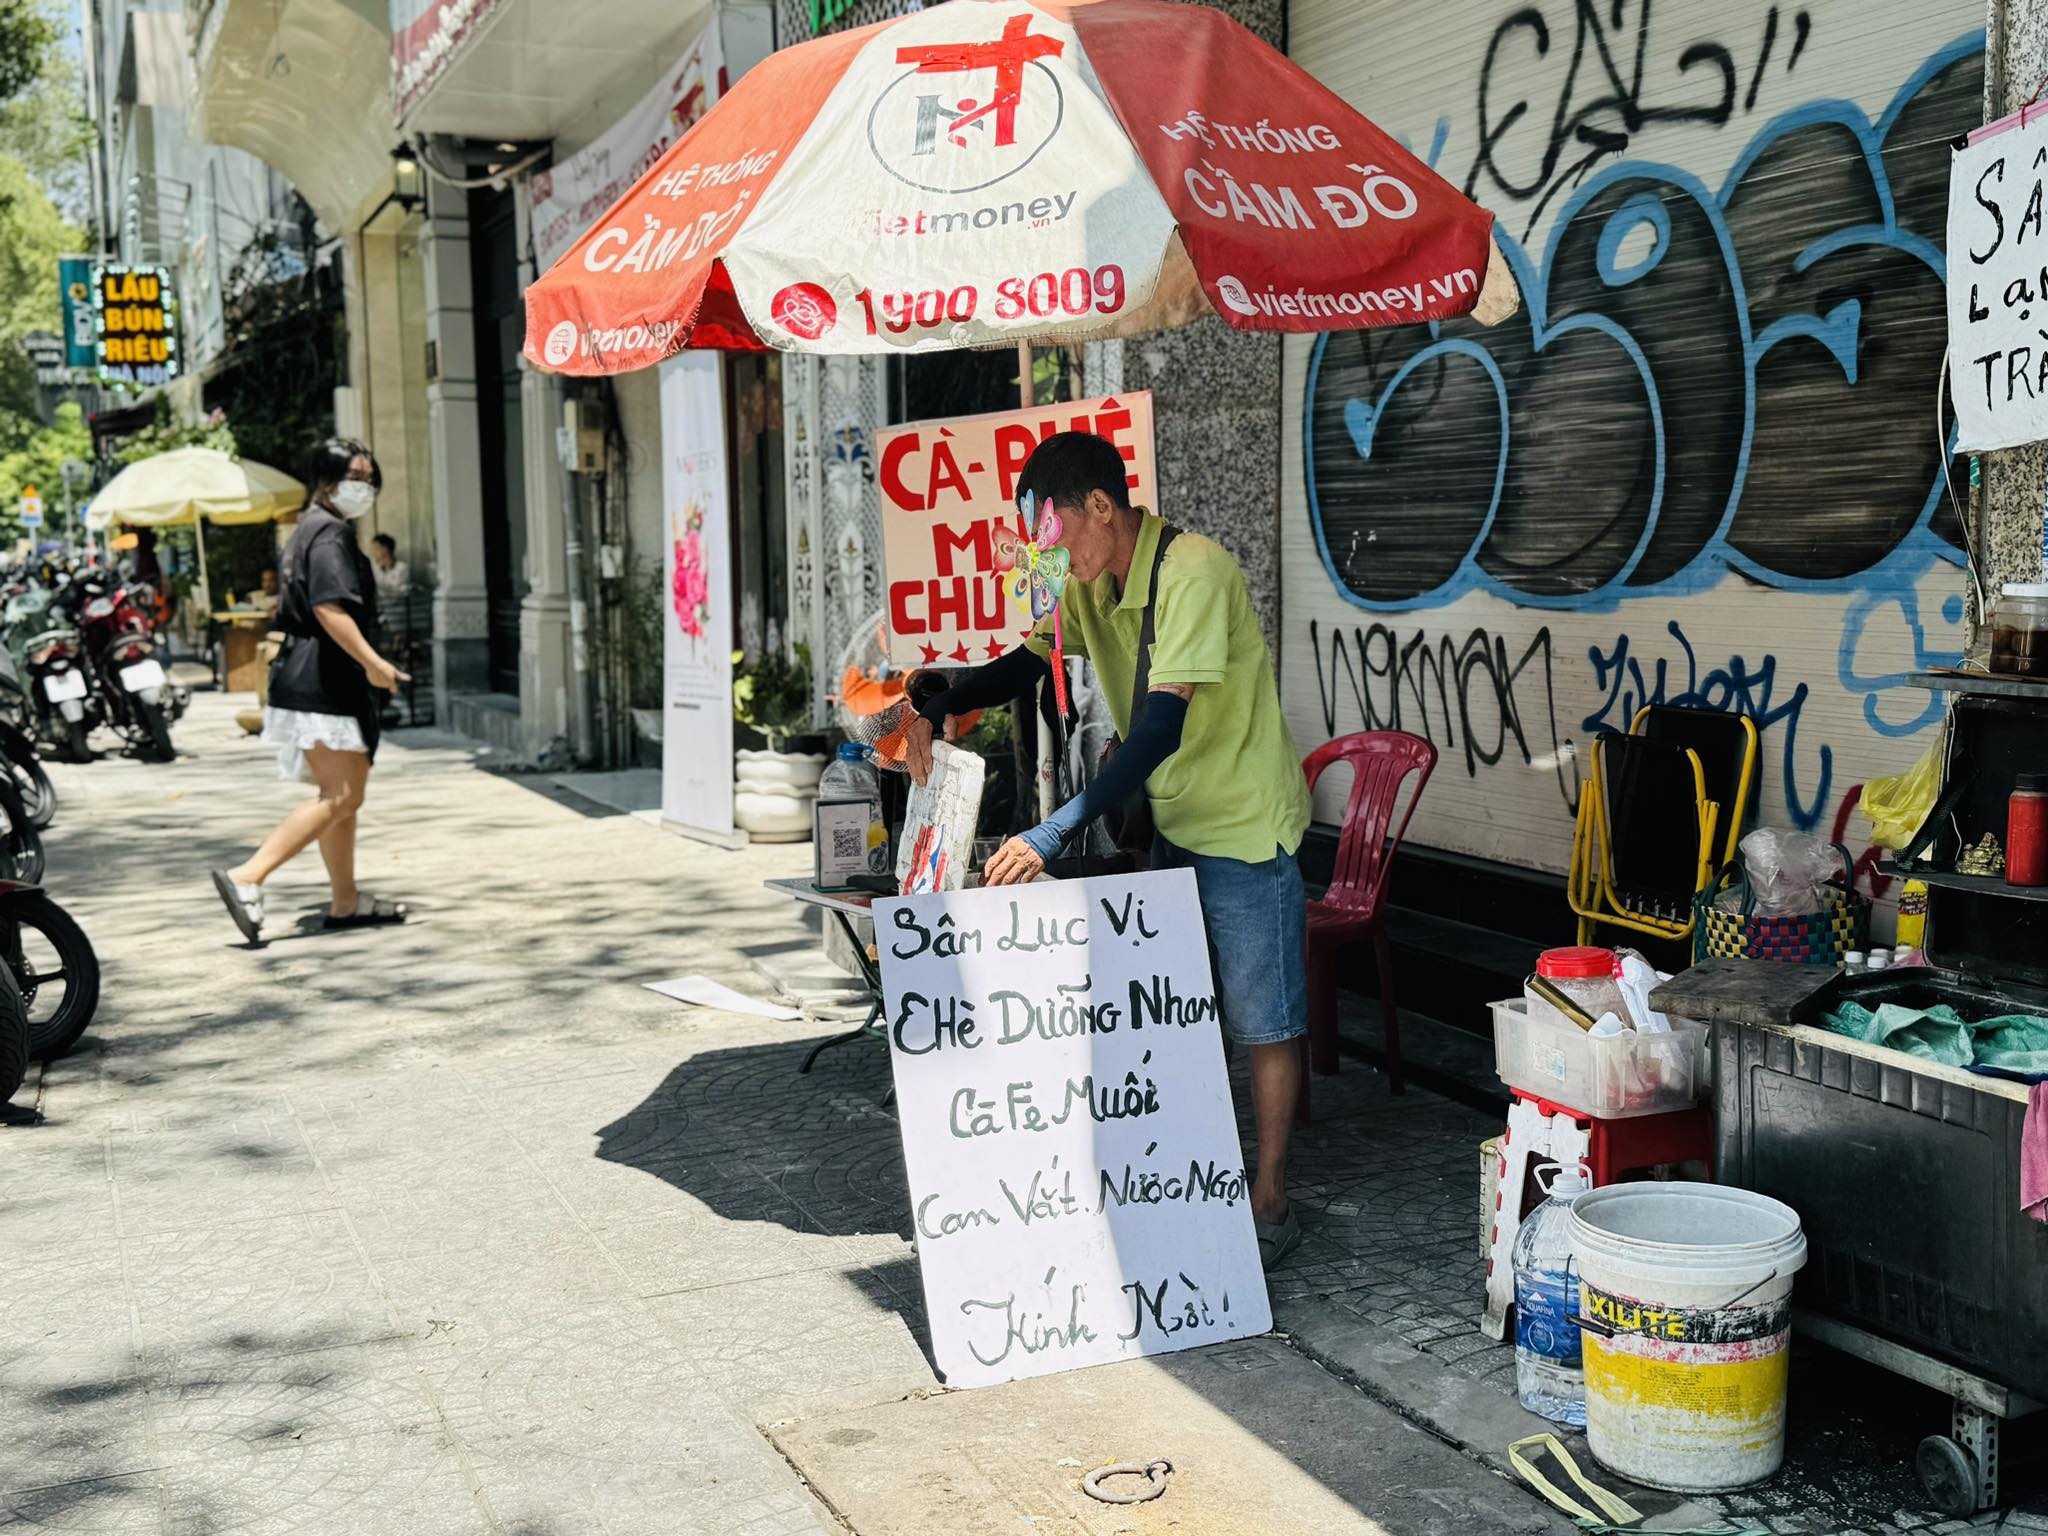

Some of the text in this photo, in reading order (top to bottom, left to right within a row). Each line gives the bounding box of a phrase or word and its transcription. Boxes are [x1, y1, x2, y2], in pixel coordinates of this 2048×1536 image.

[1159, 111, 1342, 154] HỆ THỐNG
[651, 163, 700, 201] HỆ
[696, 148, 777, 193] THỐNG
[1184, 160, 1418, 231] CẦM ĐỒ
[584, 213, 693, 273] CẦM
[681, 188, 752, 262] ĐỒ
[865, 190, 1078, 237] ietmoney
[855, 264, 1126, 335] 1900 8009
[1253, 268, 1478, 317] vietmoney.vn
[105, 333, 169, 361] RIÊU
[892, 892, 1159, 960] Sâm Lục Vị
[1051, 1050, 1160, 1124] Muối
